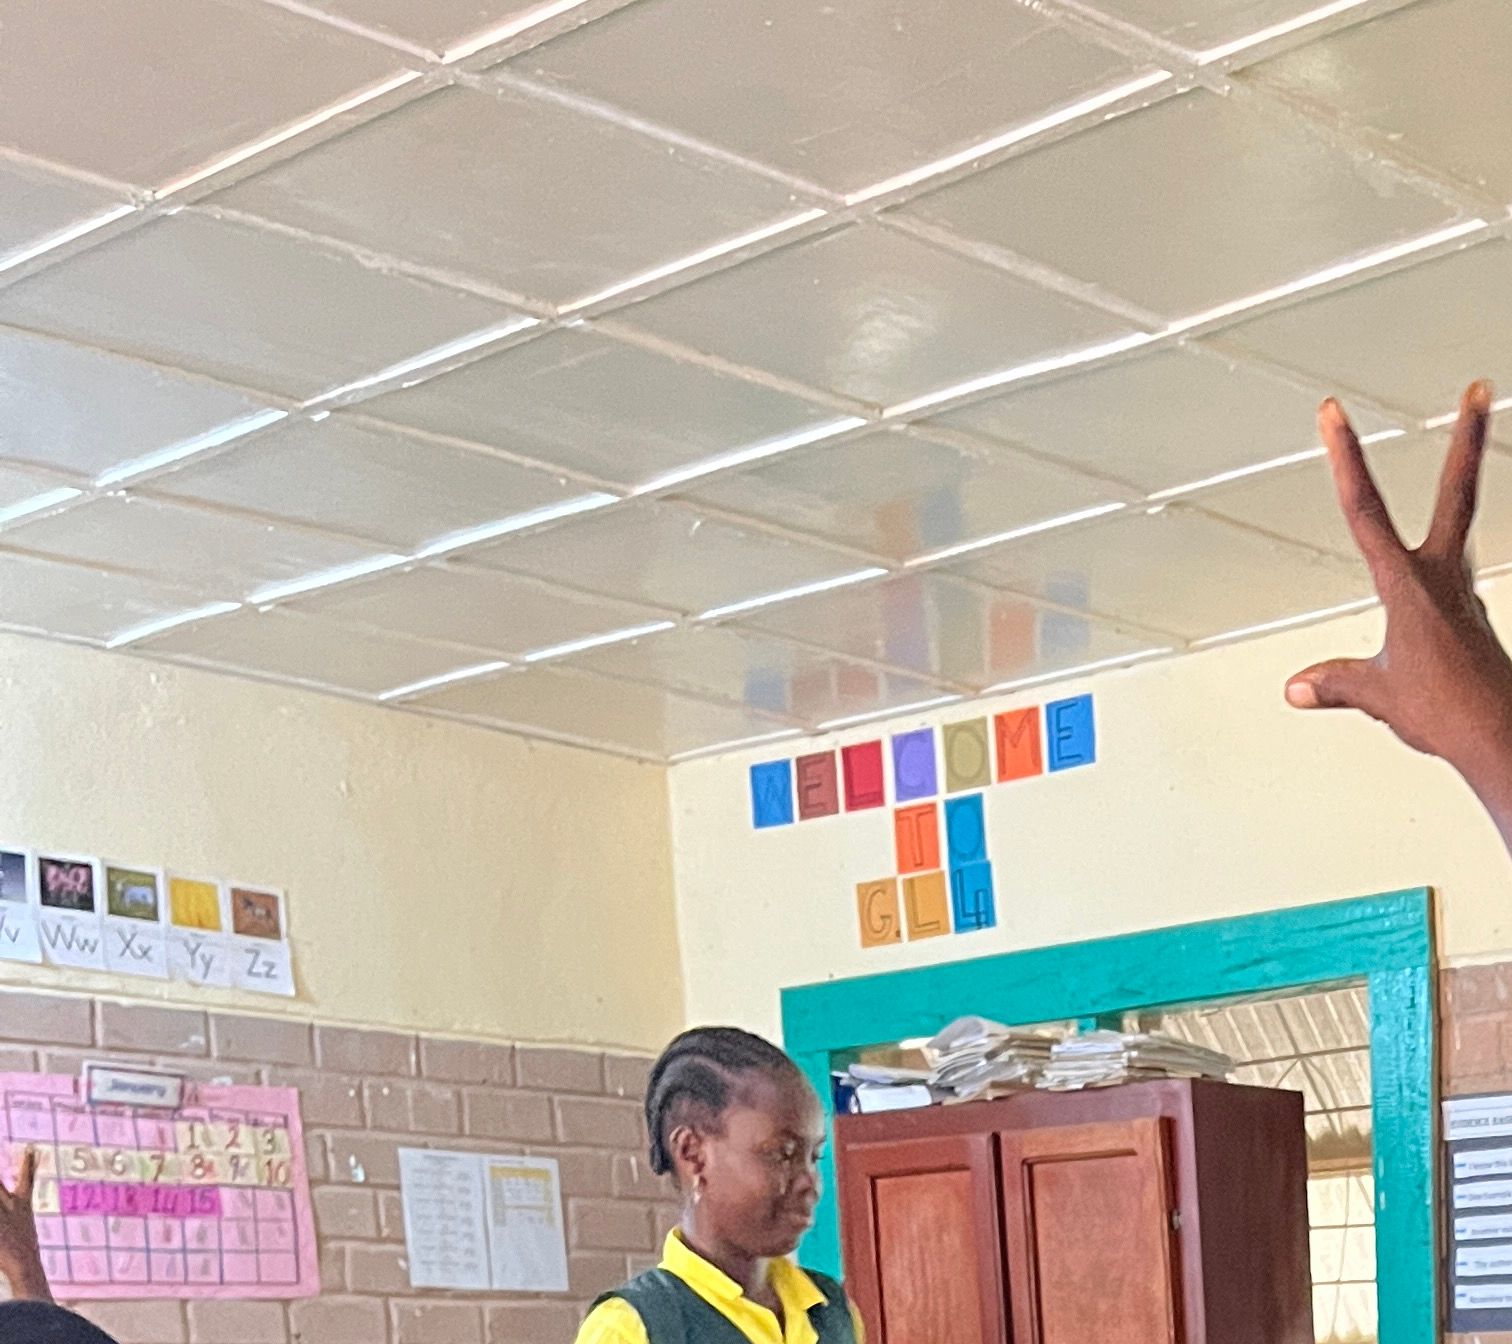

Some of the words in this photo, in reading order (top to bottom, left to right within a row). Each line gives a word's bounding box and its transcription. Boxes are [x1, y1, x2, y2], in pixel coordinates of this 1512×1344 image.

[751, 700, 1084, 826] WELCOME
[896, 801, 983, 867] TO
[183, 936, 214, 980] Yy
[245, 948, 279, 980] Zz
[262, 1129, 276, 1155] 3
[70, 1147, 90, 1173] 5
[110, 1150, 126, 1176] 6
[150, 1154, 165, 1182] 7
[191, 1153, 206, 1179] 8
